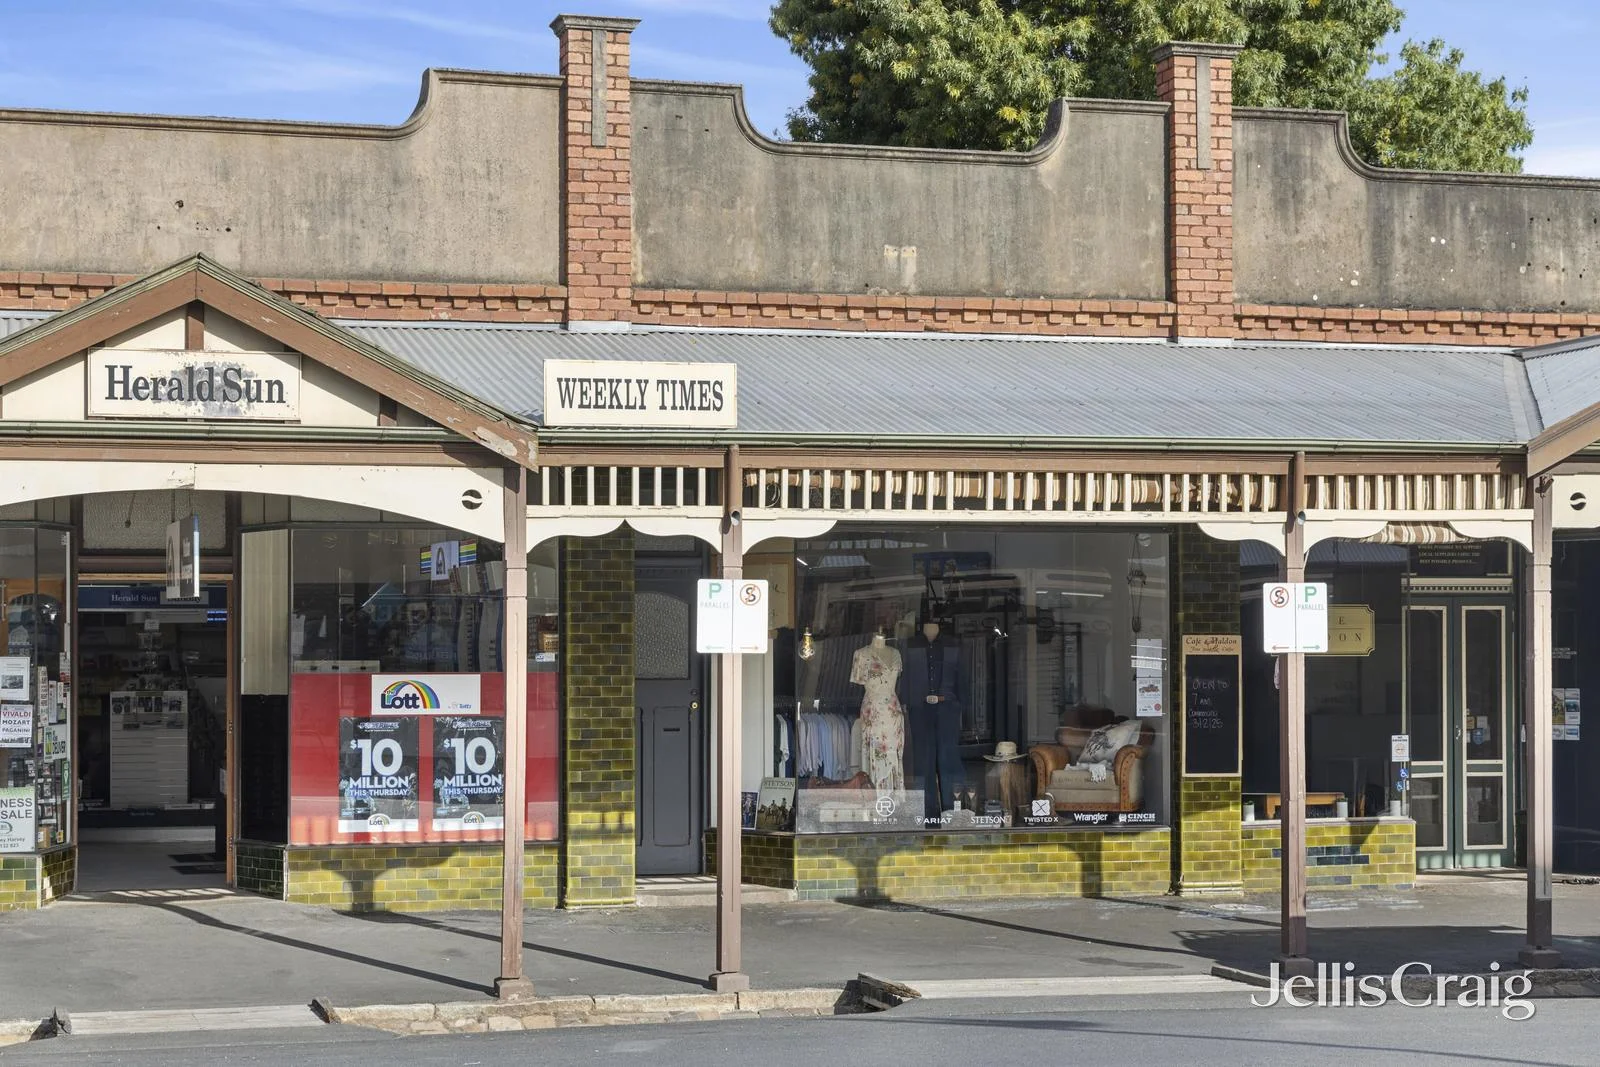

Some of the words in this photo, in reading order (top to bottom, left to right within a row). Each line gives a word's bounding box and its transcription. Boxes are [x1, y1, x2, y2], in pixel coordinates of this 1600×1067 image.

[104, 364, 216, 402] Herald
[222, 367, 286, 403] Sun
[556, 377, 649, 410] WEEKLY
[656, 379, 724, 412] TIMES
[709, 583, 722, 599] P
[1304, 586, 1317, 602] P
[380, 693, 420, 709] Lott
[350, 738, 403, 776] $10
[443, 736, 496, 774] $10
[349, 776, 409, 789] MILLION
[444, 774, 502, 788] MILLION
[350, 789, 368, 797] THIS
[369, 788, 408, 796] THURSDAY
[463, 786, 502, 794] THURSDAY
[0, 808, 33, 820] SALE
[970, 816, 1005, 825] STETSON
[1074, 813, 1108, 824] Wrangler
